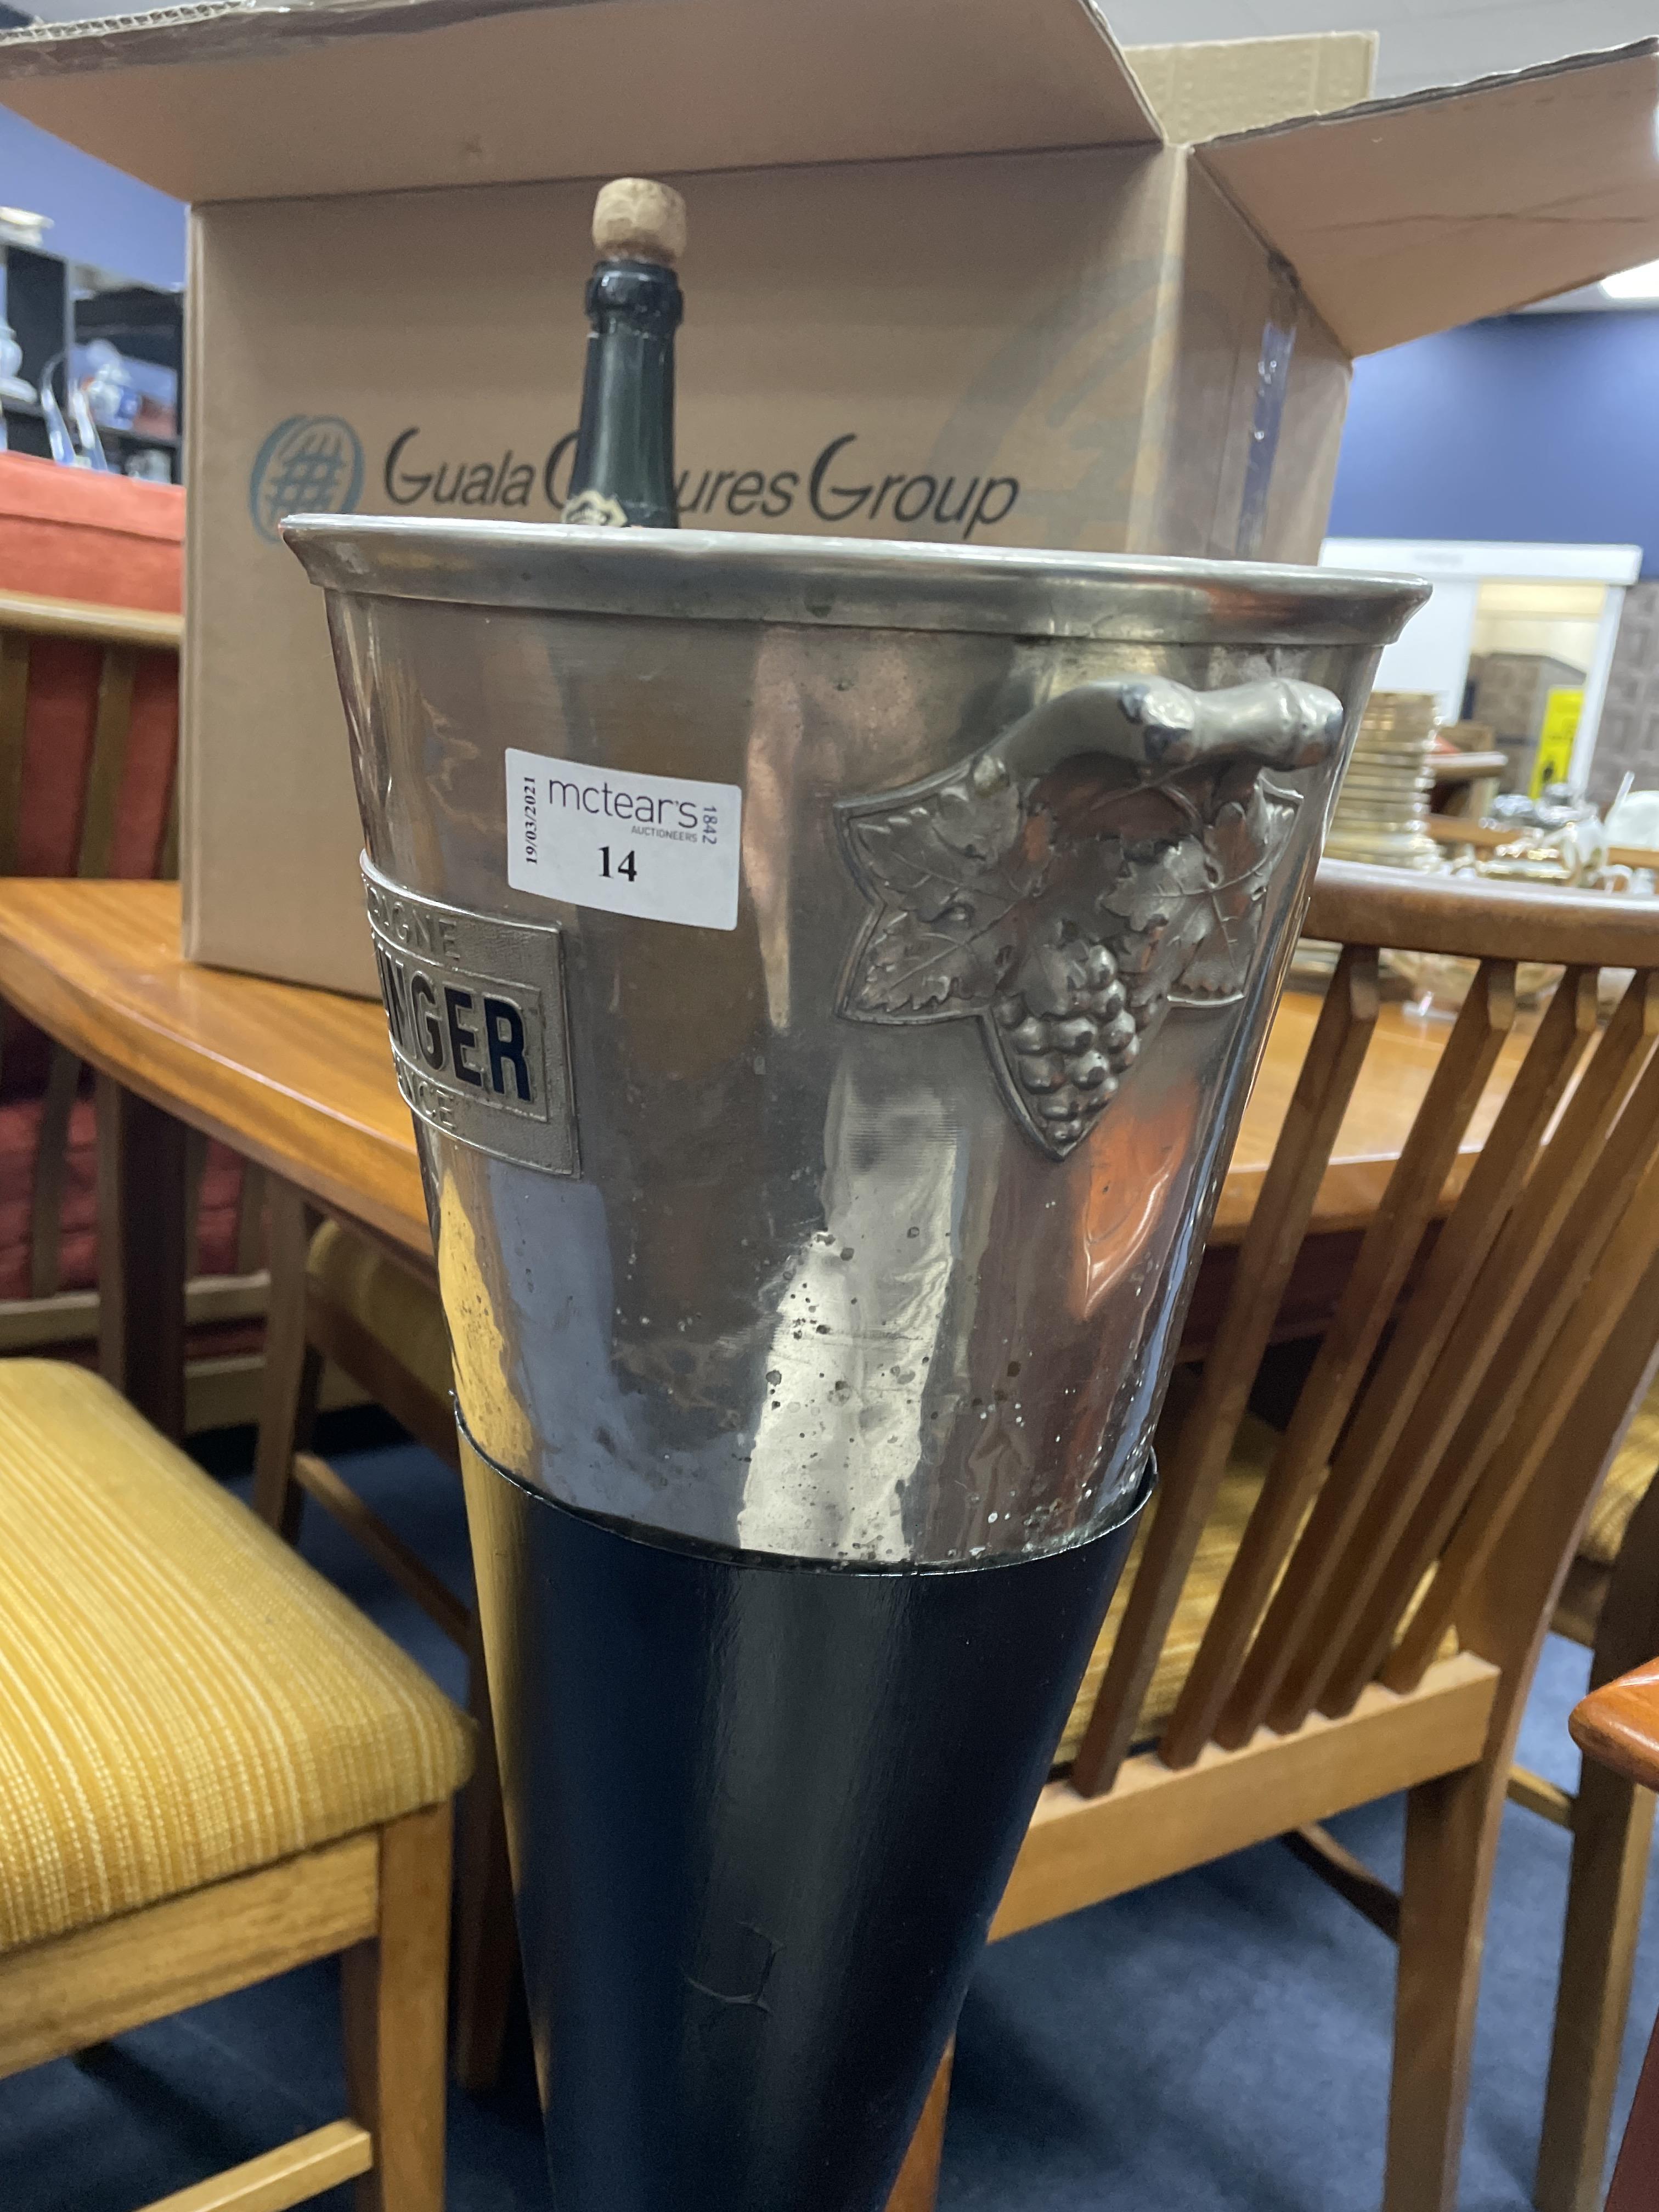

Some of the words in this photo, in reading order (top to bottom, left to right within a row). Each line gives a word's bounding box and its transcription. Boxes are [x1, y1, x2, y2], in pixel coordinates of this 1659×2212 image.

[383, 427, 534, 506] Guala
[809, 433, 1019, 540] Group
[523, 776, 538, 865] 19/03/2021
[549, 779, 698, 829] mctear's
[702, 805, 718, 845] 1842
[631, 825, 698, 842] AUCTIONEERS
[597, 845, 637, 882] 14
